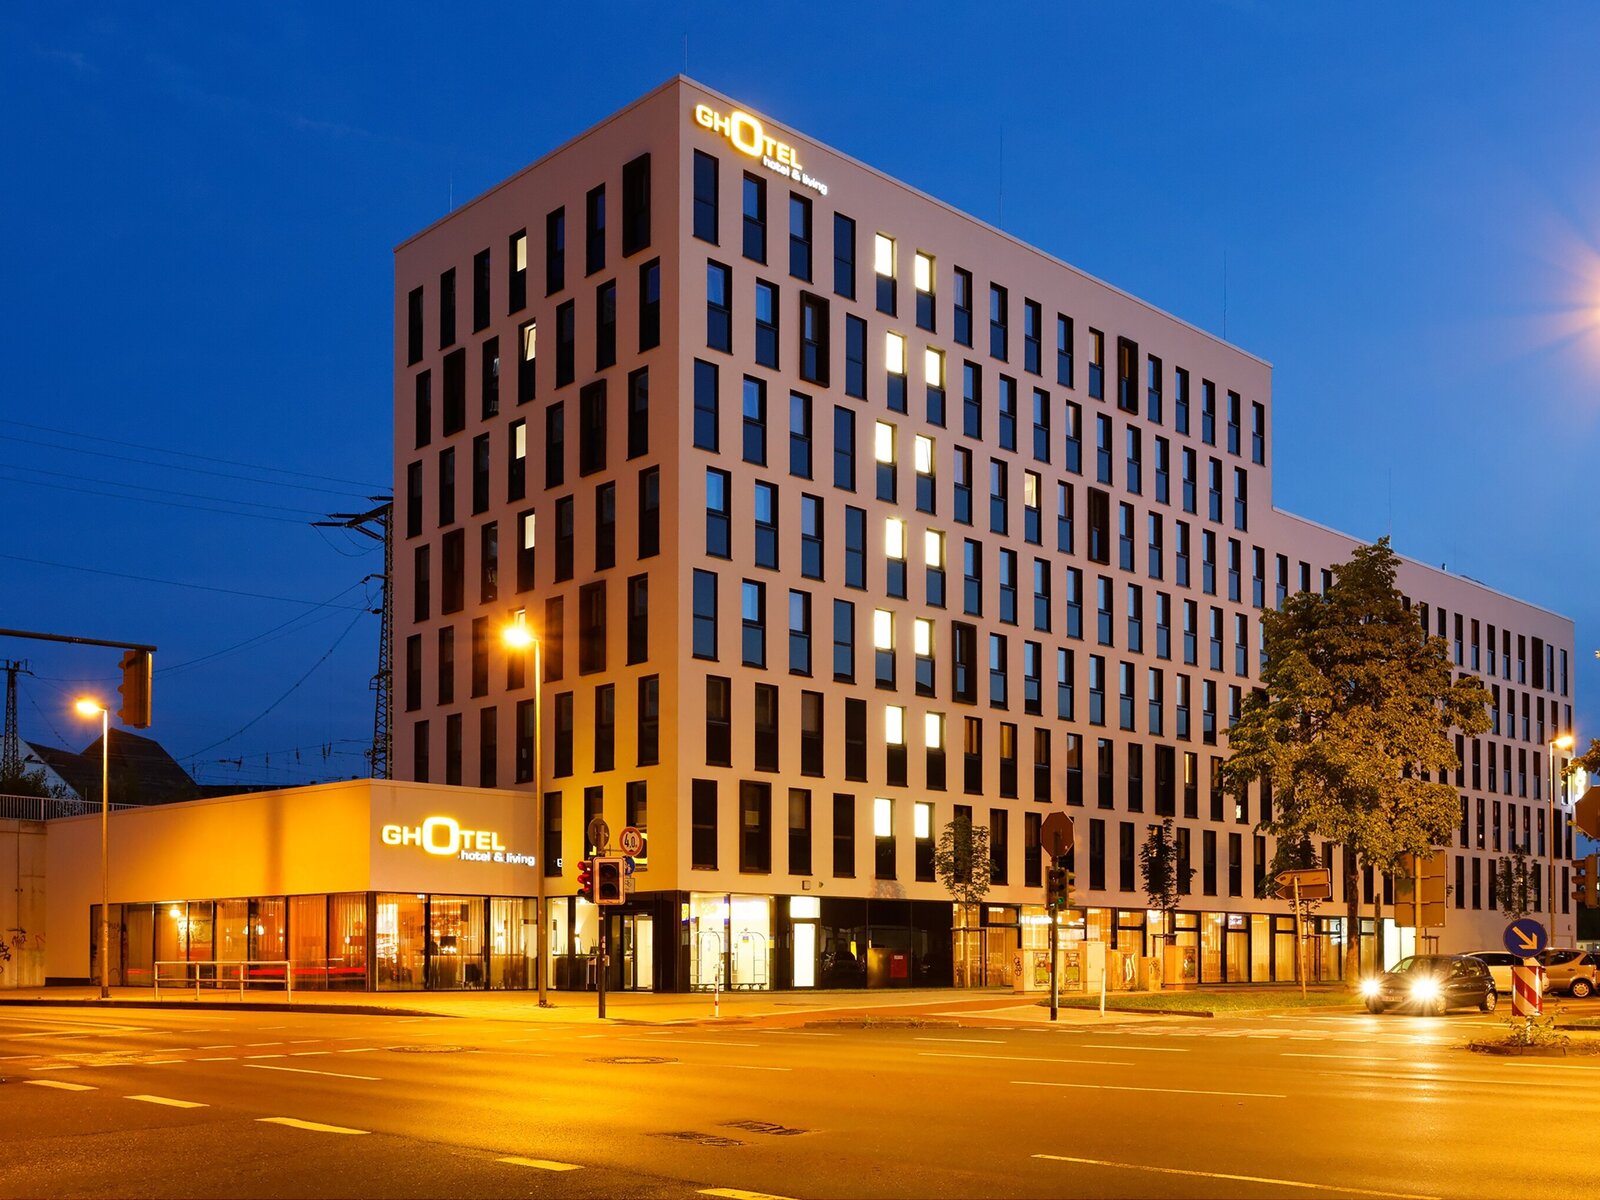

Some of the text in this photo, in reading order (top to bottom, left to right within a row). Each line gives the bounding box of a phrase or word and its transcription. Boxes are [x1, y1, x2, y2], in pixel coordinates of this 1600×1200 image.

[695, 104, 803, 171] GHOTEL
[763, 155, 828, 195] hotel & living
[382, 816, 506, 855] GHOTEL
[460, 850, 535, 866] hotel & living
